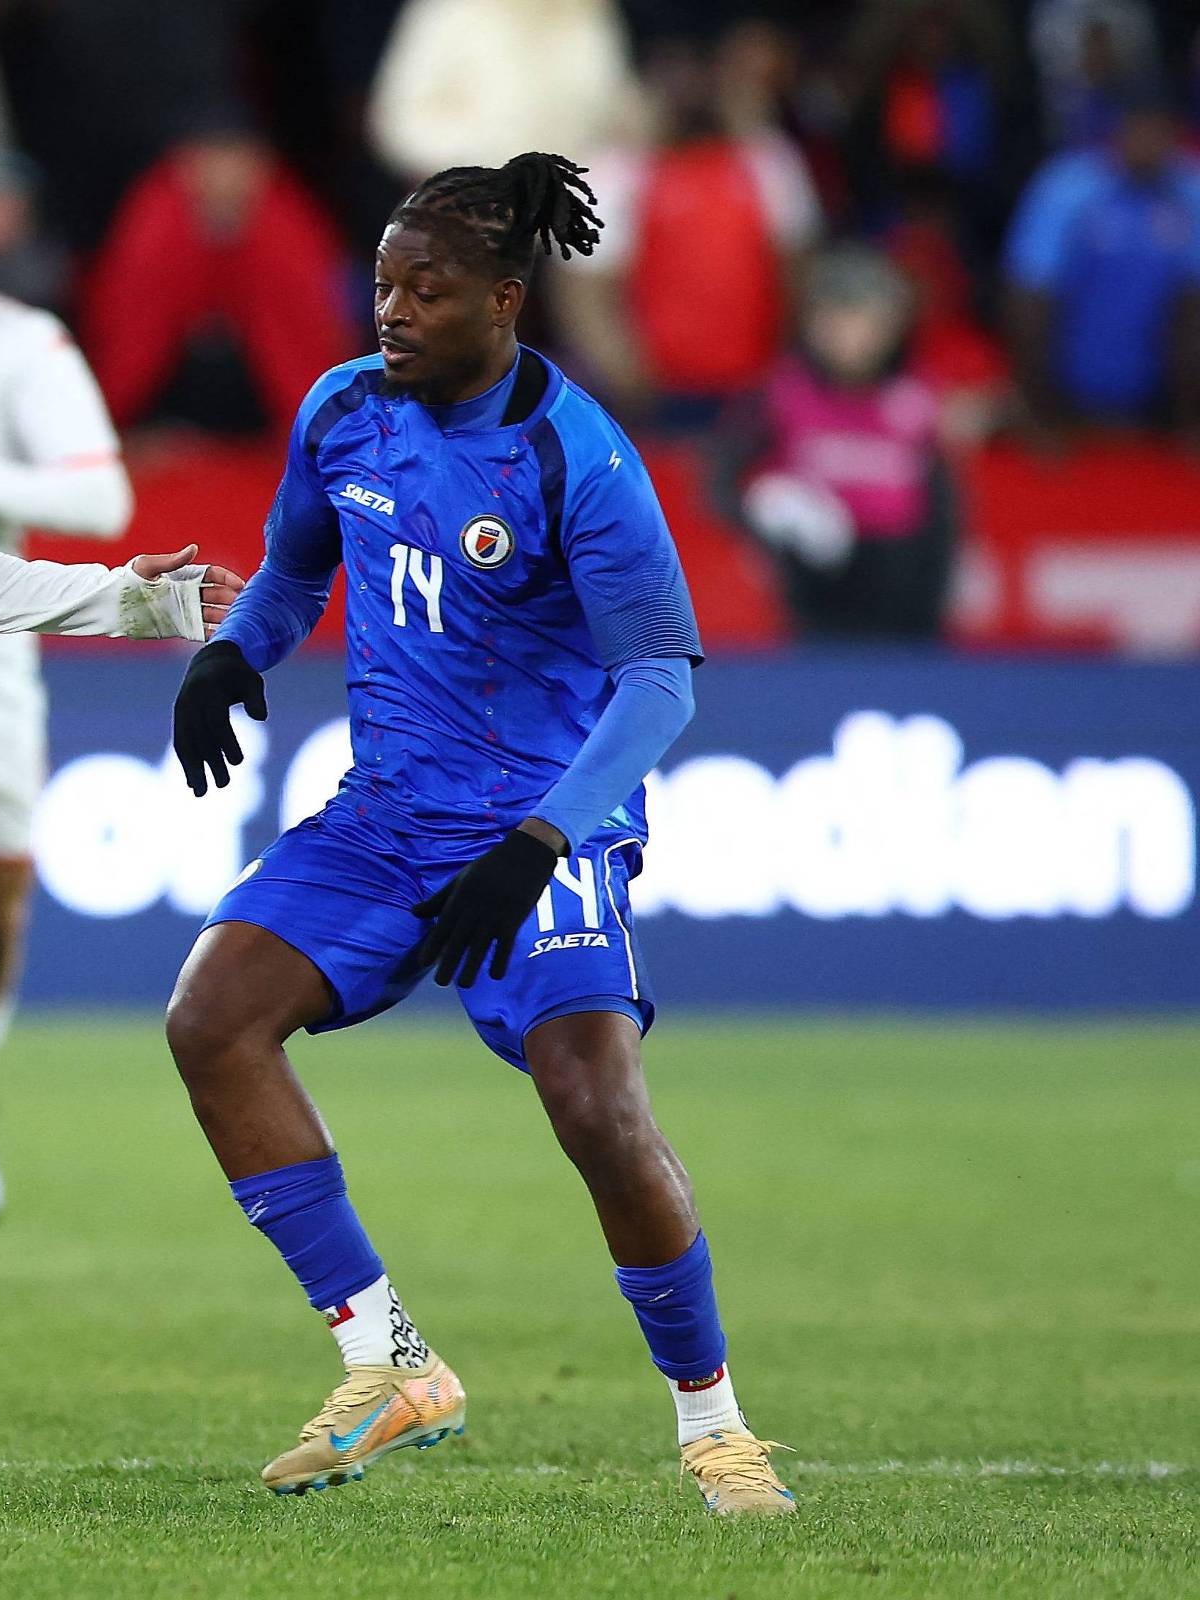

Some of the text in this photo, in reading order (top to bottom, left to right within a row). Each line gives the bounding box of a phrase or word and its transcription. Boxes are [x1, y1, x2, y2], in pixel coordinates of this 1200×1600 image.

[339, 483, 395, 516] SAETA
[389, 543, 445, 633] 14
[527, 932, 610, 958] SAETA
